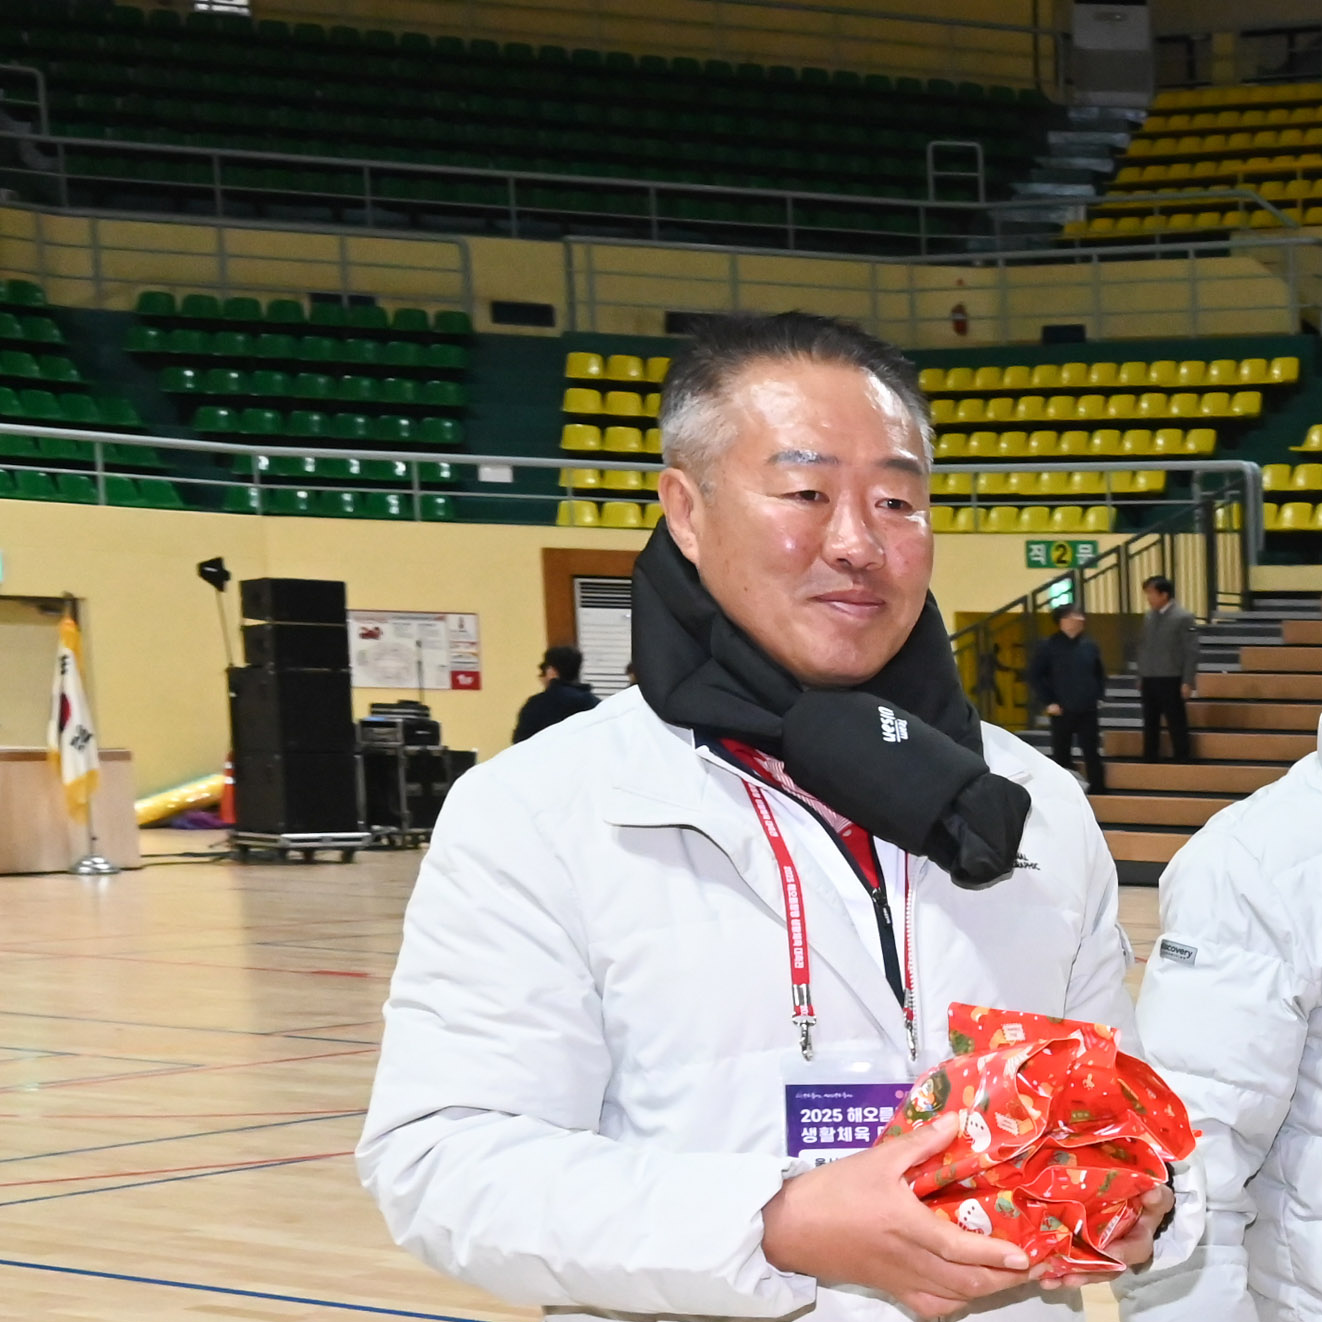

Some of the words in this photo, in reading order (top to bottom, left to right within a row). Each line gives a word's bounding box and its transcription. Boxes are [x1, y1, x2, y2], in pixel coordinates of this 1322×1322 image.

[1055, 543, 1068, 564] 2
[800, 1108, 843, 1123] 2025
[847, 1107, 894, 1122] 해오름
[801, 1126, 870, 1143] 생활체육
